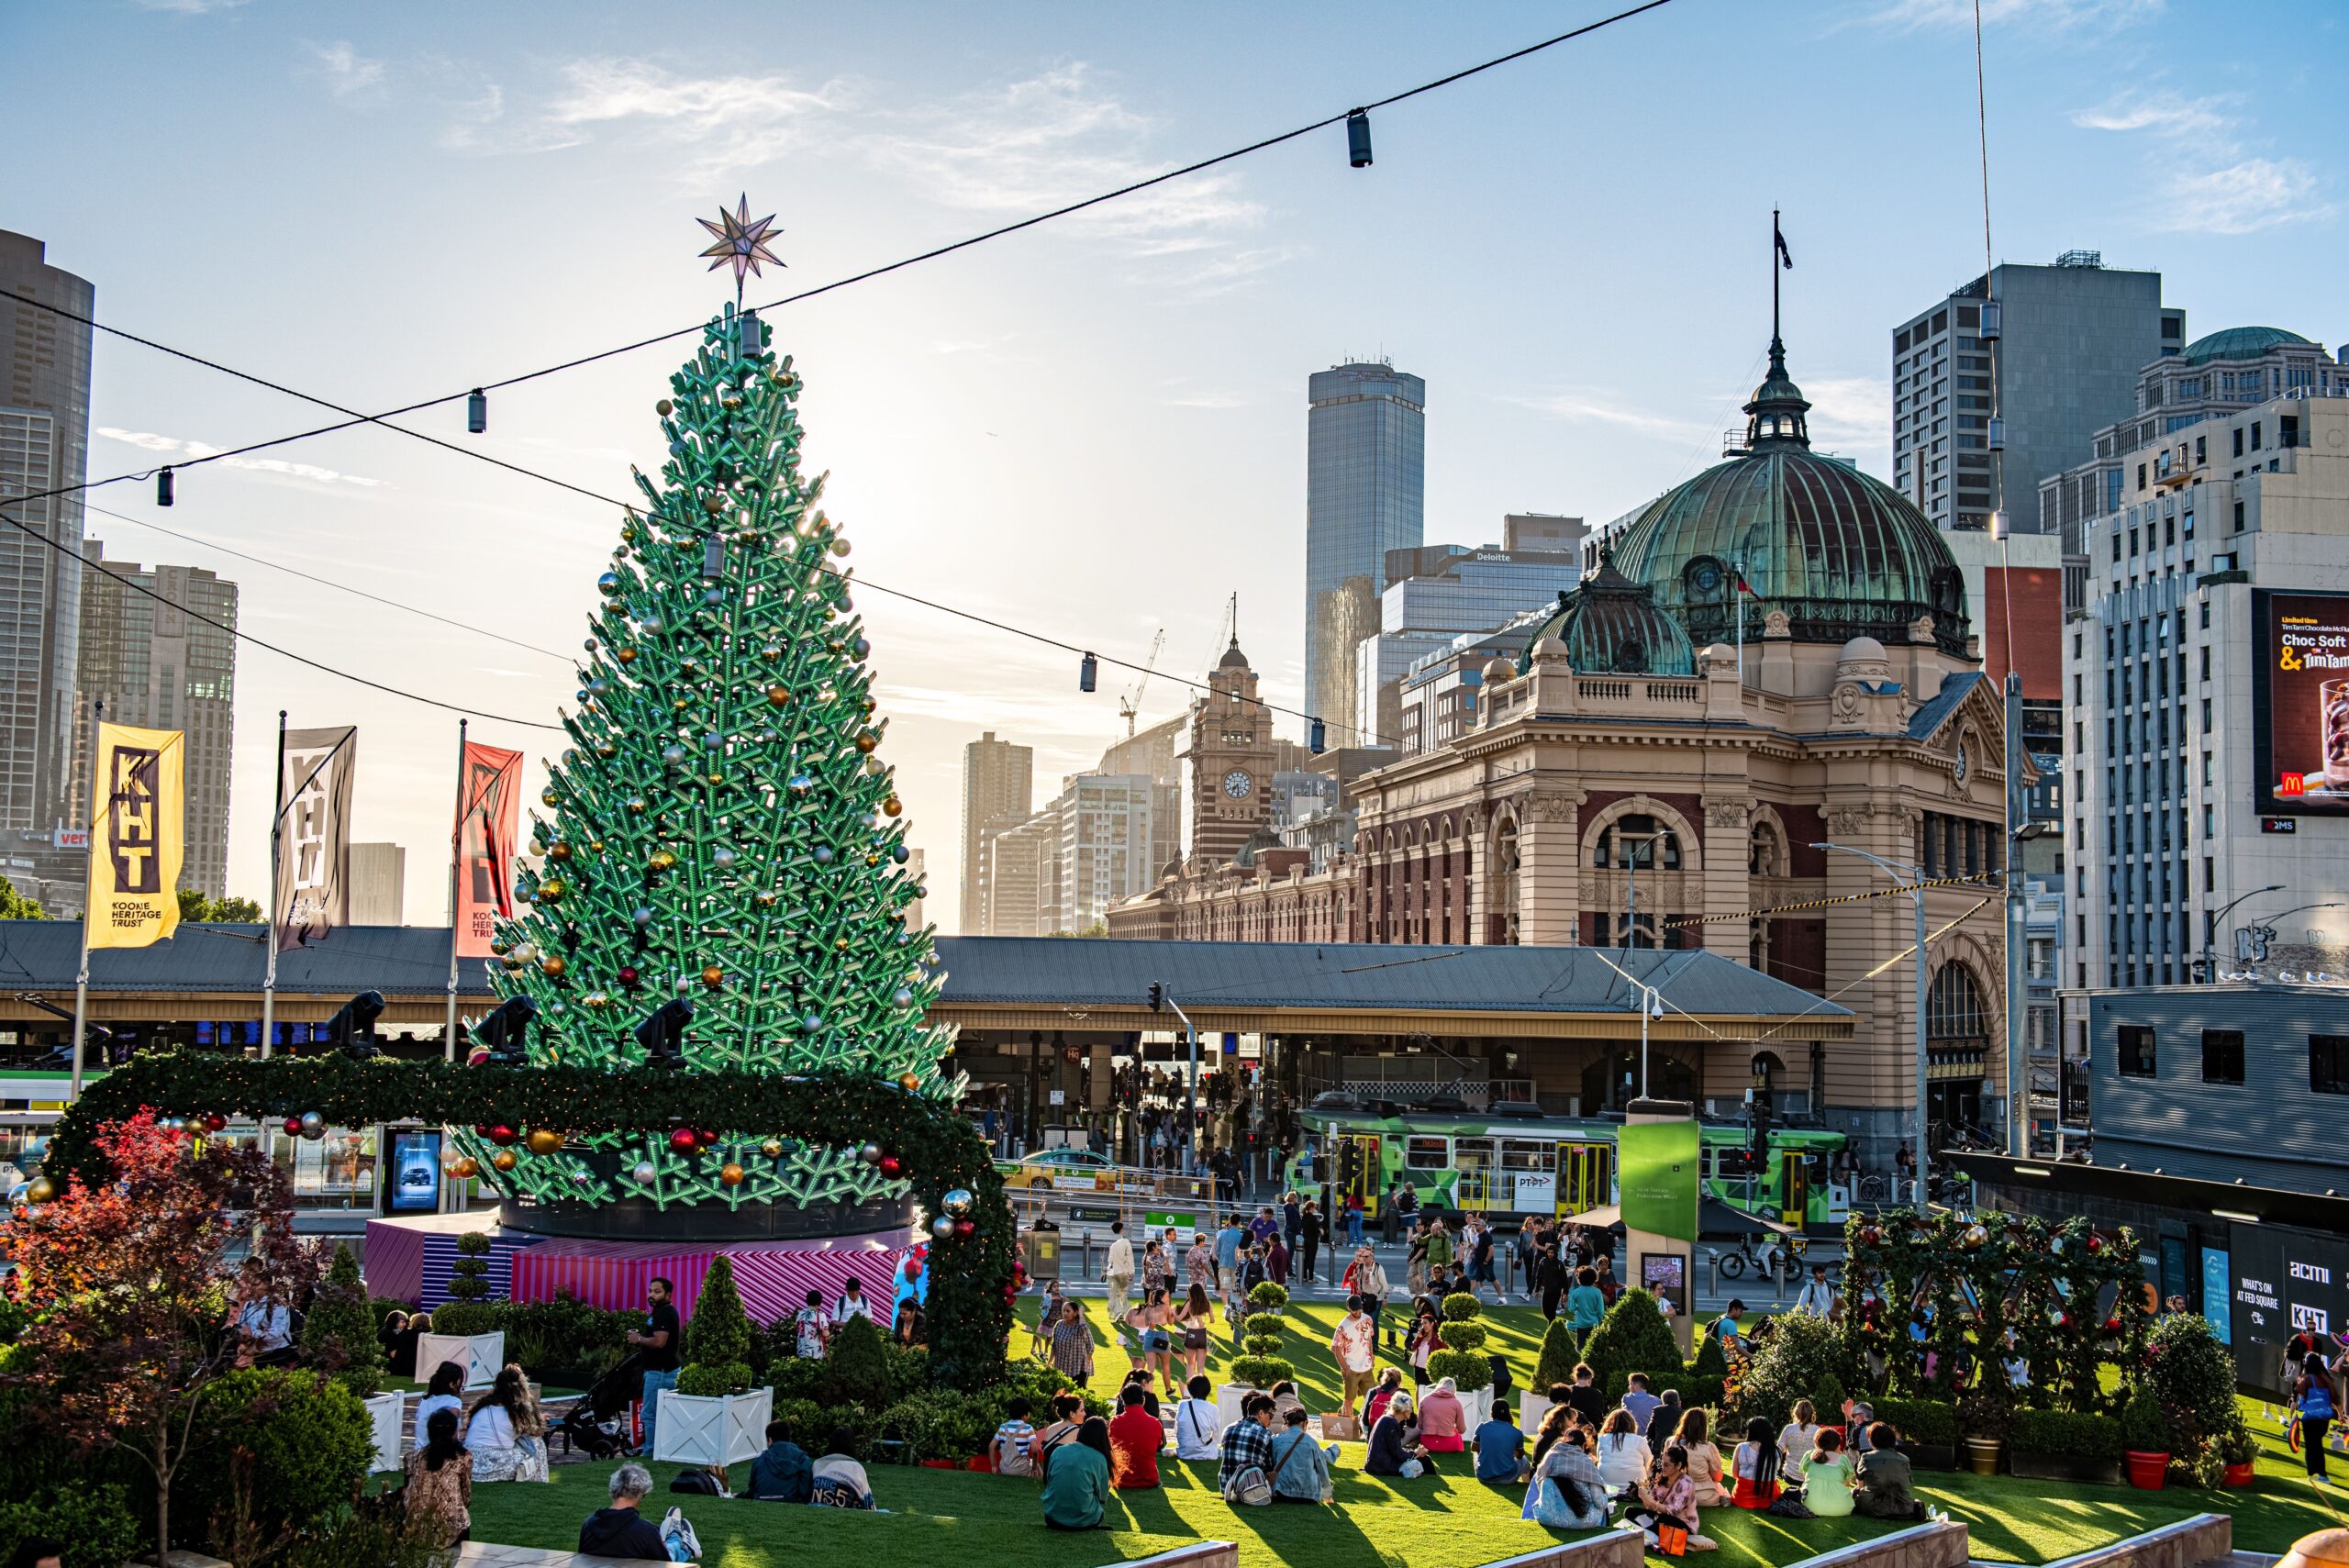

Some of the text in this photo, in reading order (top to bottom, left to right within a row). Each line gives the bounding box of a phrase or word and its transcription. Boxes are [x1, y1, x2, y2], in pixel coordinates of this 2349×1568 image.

[2282, 634, 2347, 648] Choc Soft
[2280, 646, 2302, 671] &
[112, 910, 161, 919] HERITAGE
[112, 919, 145, 928] TRUST
[1226, 1062, 1234, 1076] 3
[2289, 1261, 2330, 1284] acmi
[2242, 1277, 2273, 1295] WHAT'S ON
[2237, 1290, 2244, 1301] AT
[2244, 1292, 2255, 1304] FED
[2255, 1295, 2279, 1310] SQUARE
